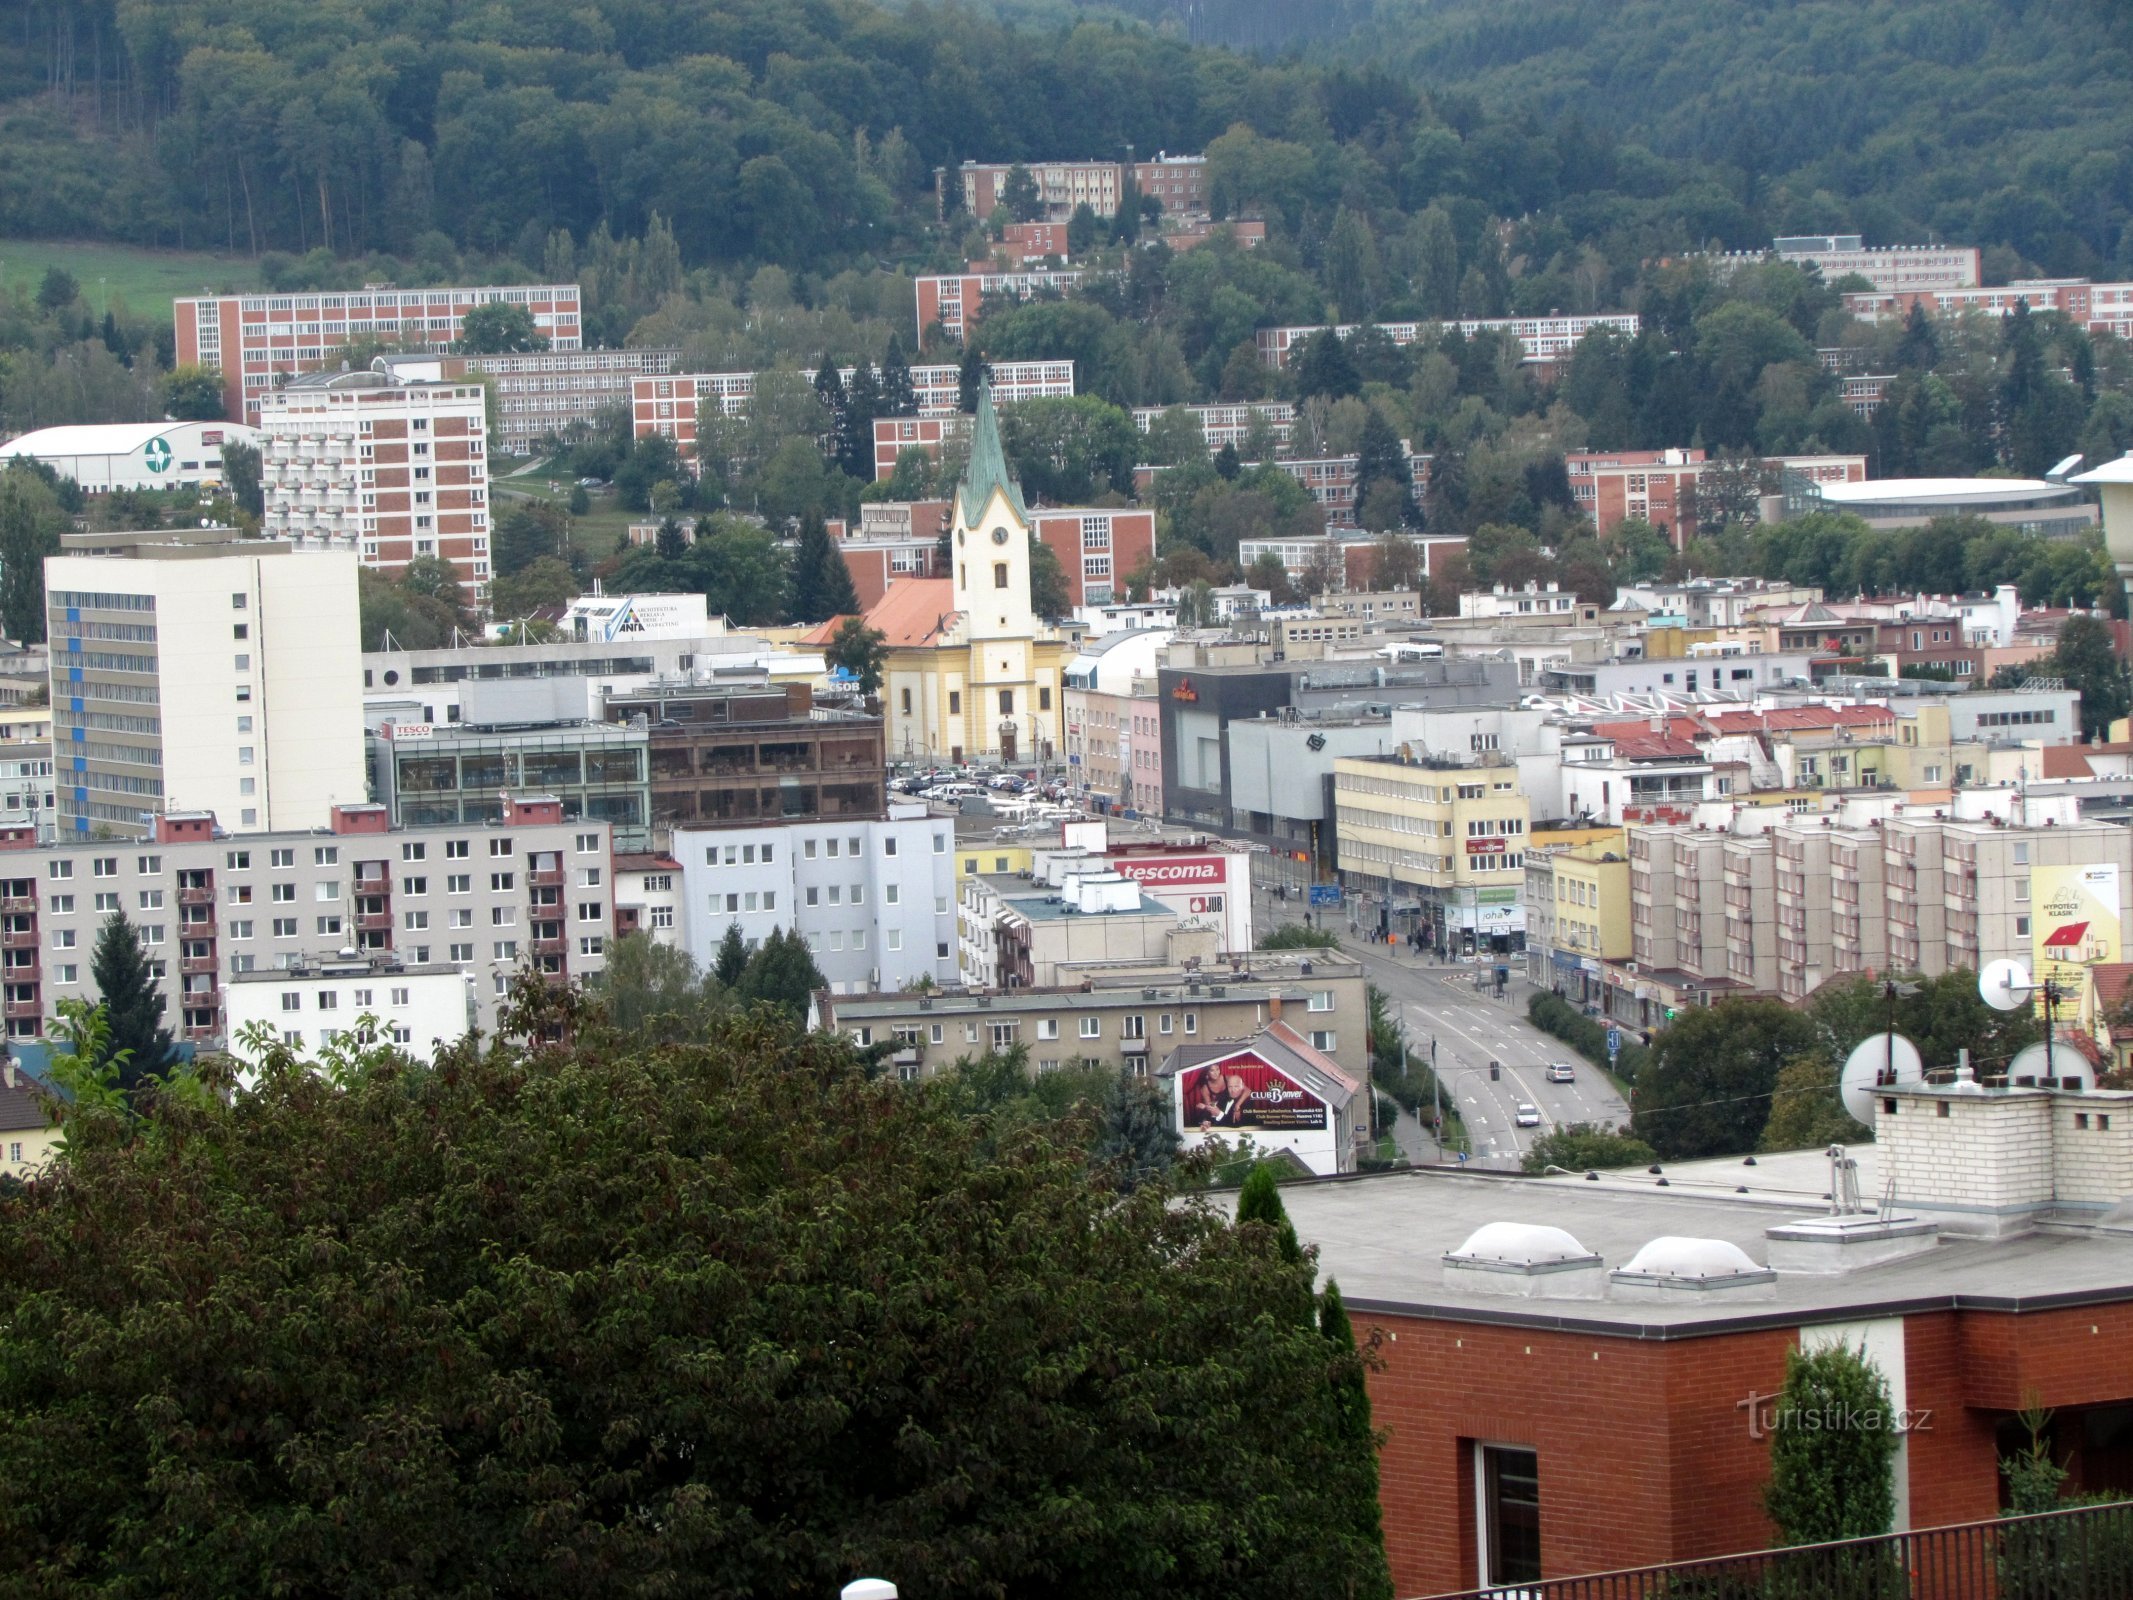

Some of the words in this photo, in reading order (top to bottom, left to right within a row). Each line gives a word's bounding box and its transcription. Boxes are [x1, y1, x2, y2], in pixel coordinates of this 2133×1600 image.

[397, 725, 430, 733] TESCO
[1206, 896, 1222, 913] JUB
[1250, 1090, 1270, 1099] CLUB
